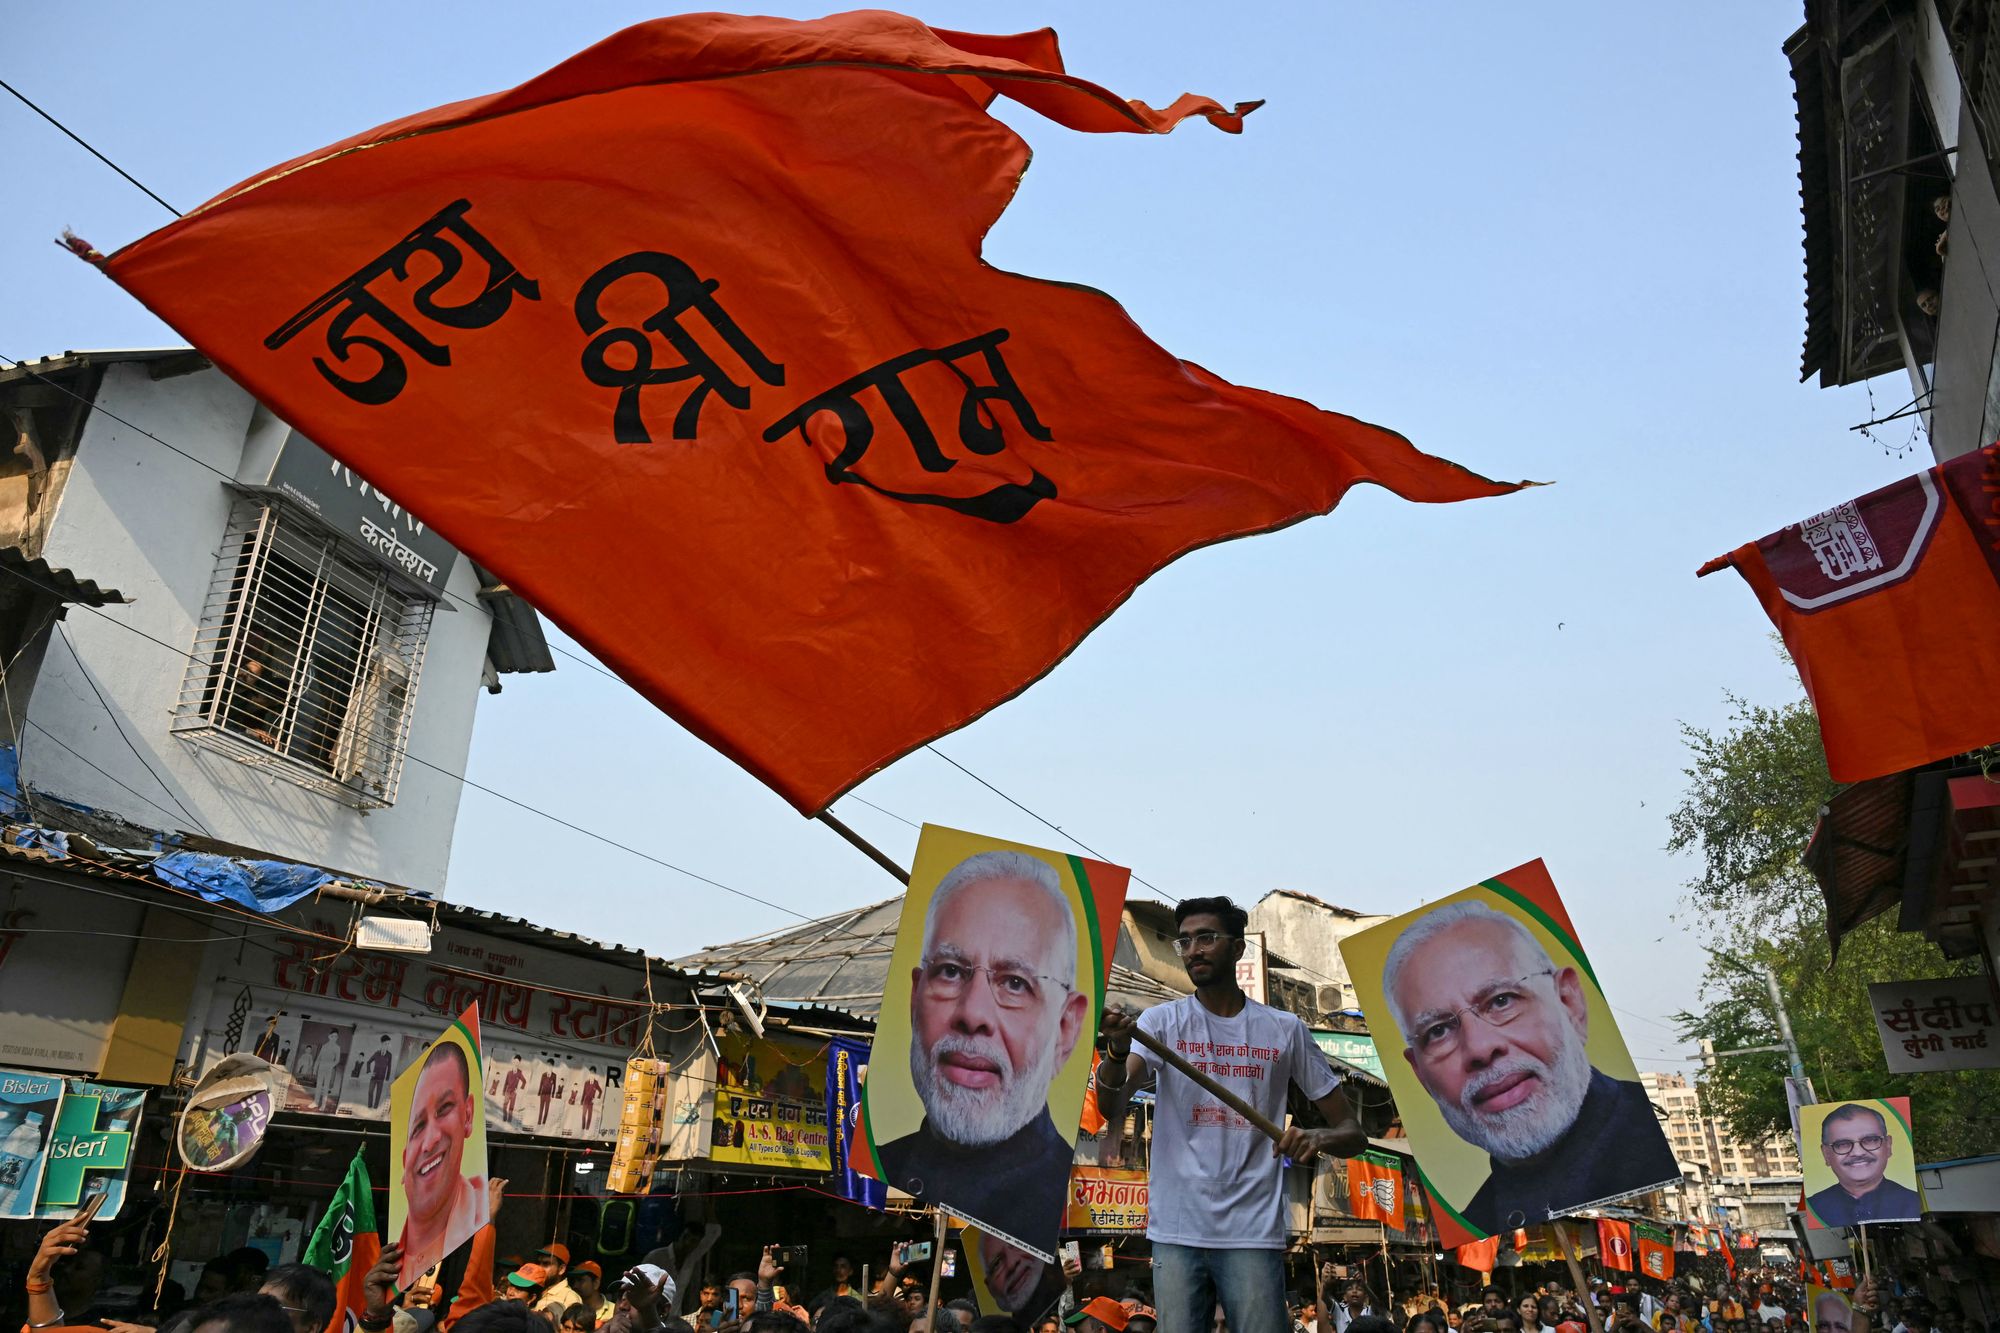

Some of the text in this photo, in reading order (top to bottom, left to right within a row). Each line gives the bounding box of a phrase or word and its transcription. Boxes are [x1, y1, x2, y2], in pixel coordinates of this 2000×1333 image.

[264, 198, 1058, 525] जय श्री राम
[359, 516, 438, 584] कलेक्शन
[1881, 997, 1993, 1033] संदीप
[1189, 1041, 1206, 1058] प्रभु
[1216, 1044, 1235, 1058] राम
[1237, 1042, 1249, 1057] को
[1317, 1038, 1373, 1055] uty Care
[1901, 1029, 1988, 1059] लुंगी मार्ट
[1, 1079, 51, 1096] Bisleri
[749, 1122, 829, 1146] A. S. Bag Centre
[51, 1135, 109, 1160] isleri
[749, 1142, 758, 1152] All
[758, 1143, 774, 1154] Types
[774, 1144, 782, 1153] Of
[781, 1145, 795, 1156] Bags
[800, 1147, 822, 1159] Luggage
[1090, 1208, 1124, 1226] रेडीमेड
